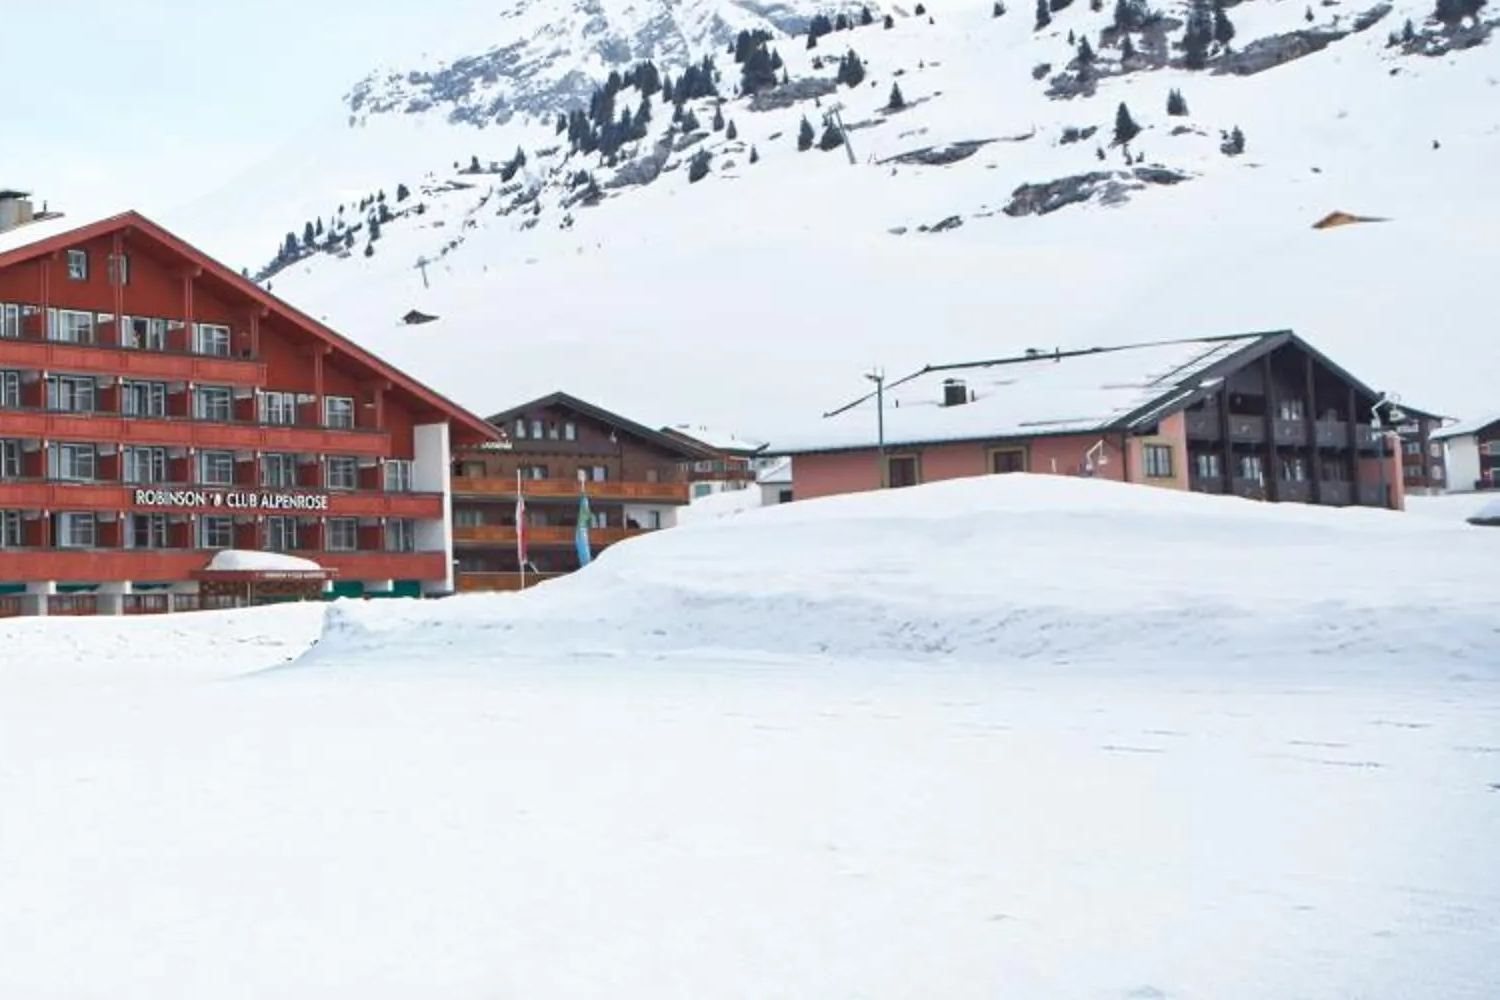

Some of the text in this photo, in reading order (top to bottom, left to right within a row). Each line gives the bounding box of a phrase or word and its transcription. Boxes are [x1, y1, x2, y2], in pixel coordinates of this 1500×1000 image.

[136, 489, 328, 510] ROBINSON CLUB ALPENROSE
